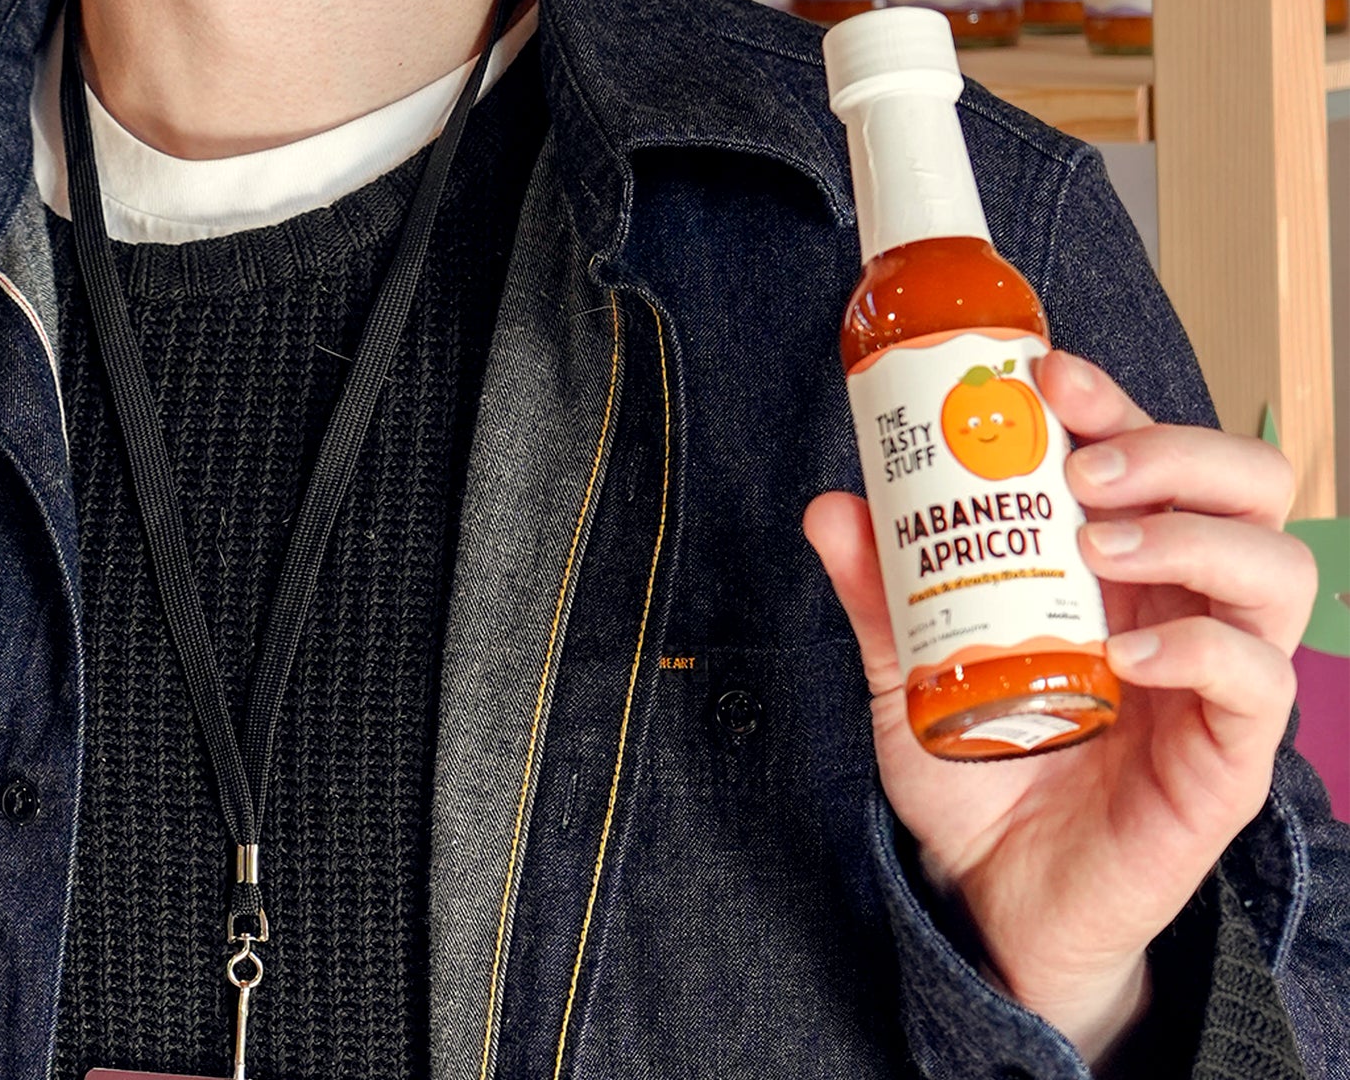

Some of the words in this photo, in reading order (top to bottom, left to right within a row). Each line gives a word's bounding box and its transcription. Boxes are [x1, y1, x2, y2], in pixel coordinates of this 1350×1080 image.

[876, 406, 908, 436] THE
[881, 421, 932, 459] TASTY
[885, 444, 935, 483] STUFF
[895, 491, 1052, 549] HABANERO
[919, 527, 1041, 578] APRICOT
[659, 657, 696, 669] HEART
